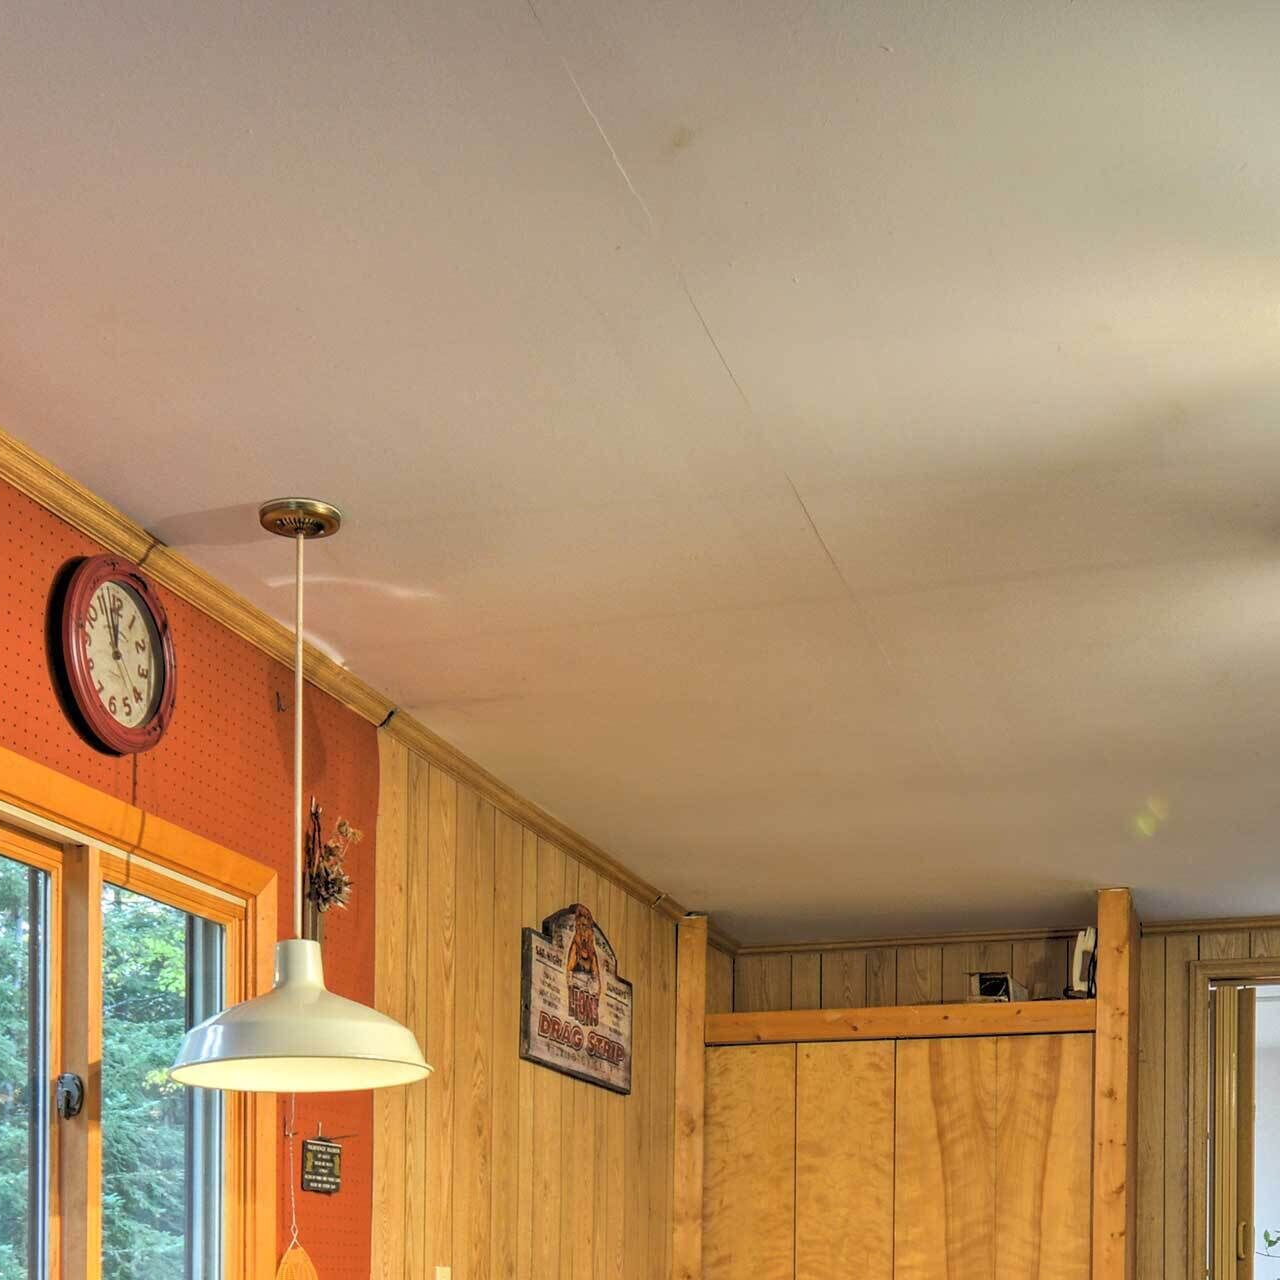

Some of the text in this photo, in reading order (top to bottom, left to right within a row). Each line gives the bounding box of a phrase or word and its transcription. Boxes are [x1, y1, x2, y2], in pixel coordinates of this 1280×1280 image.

[135, 639, 146, 654] 2
[137, 665, 148, 680] 3
[133, 686, 143, 704] 4
[108, 696, 117, 715] 6
[122, 696, 132, 716] 5
[538, 1010, 584, 1051] DRAG
[585, 1031, 625, 1066] STRIP
